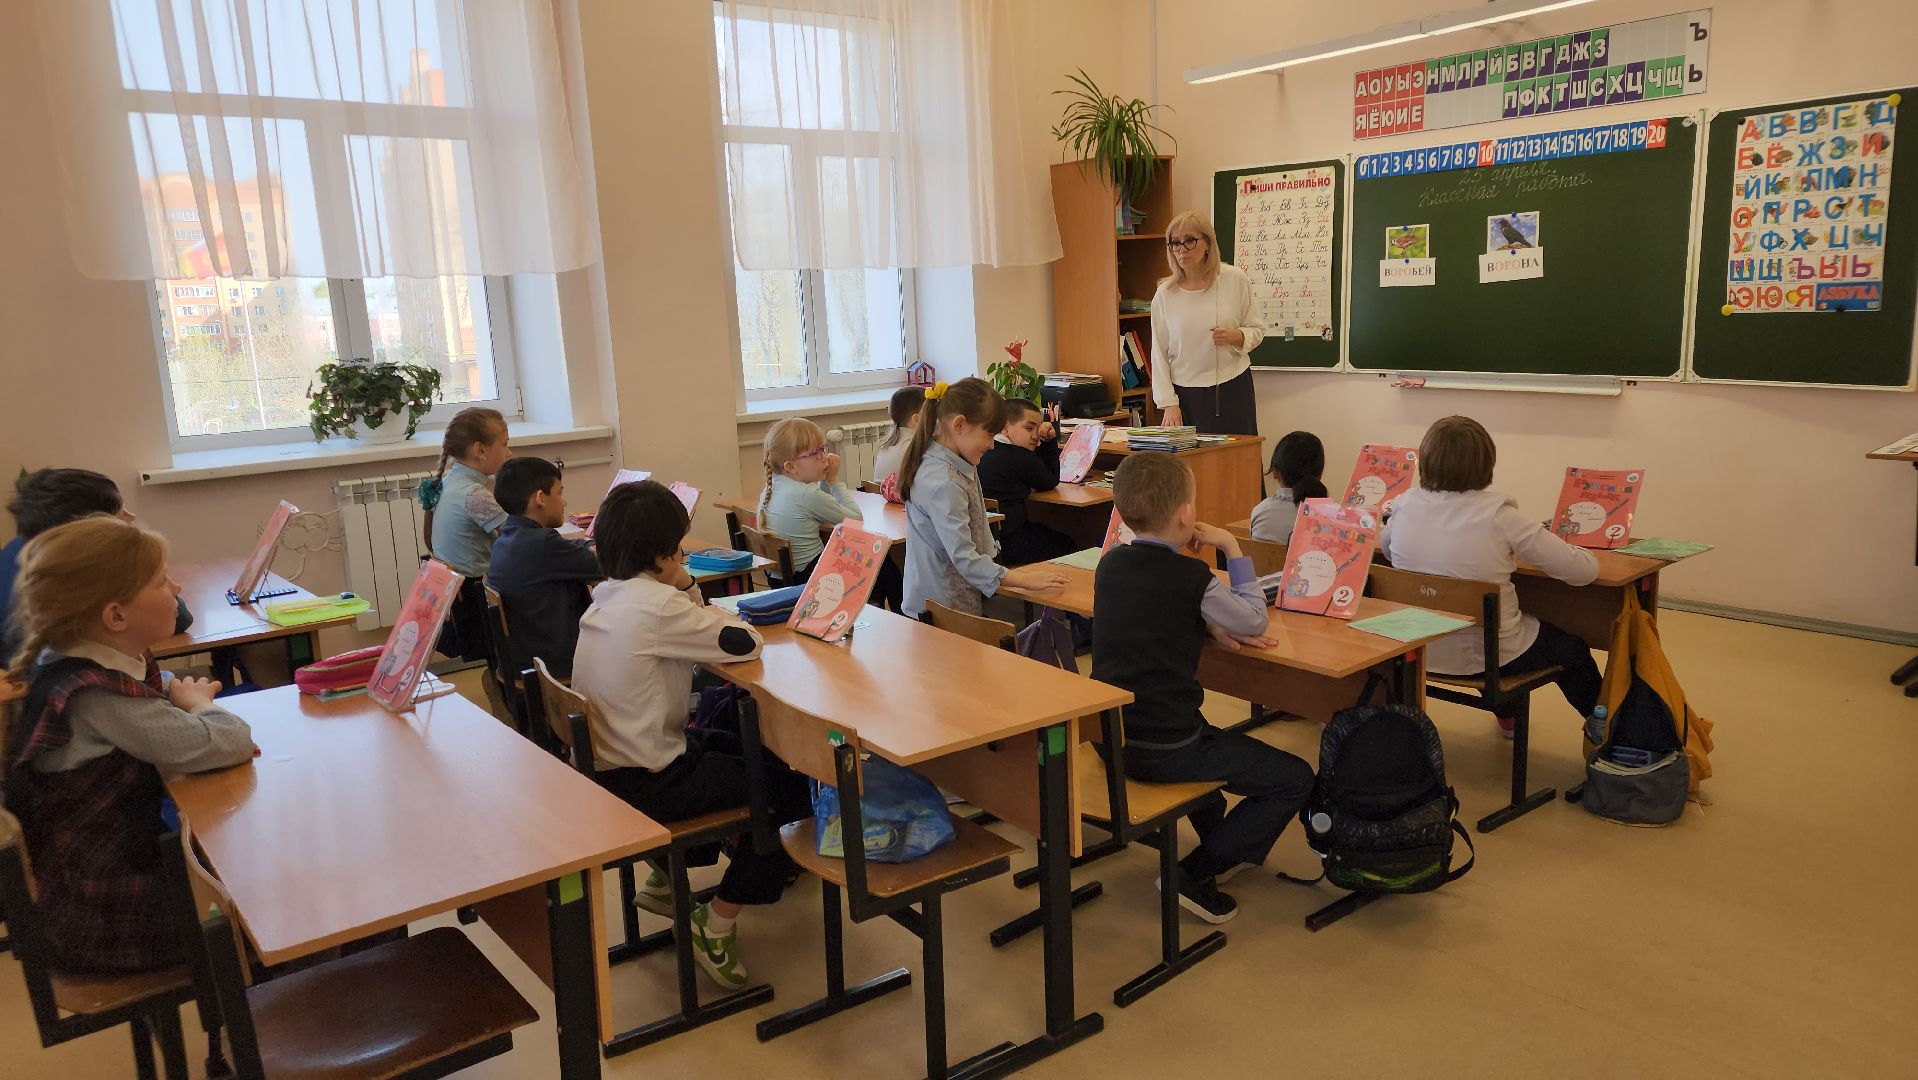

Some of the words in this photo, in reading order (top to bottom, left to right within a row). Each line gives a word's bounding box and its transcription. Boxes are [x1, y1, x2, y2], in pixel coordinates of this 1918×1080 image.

[1741, 120, 1760, 142] А
[1769, 114, 1787, 138] Б
[1800, 111, 1818, 134] В
[1833, 105, 1853, 130] Г
[1360, 159, 1368, 175] 0
[1372, 159, 1377, 174] 1
[1382, 157, 1389, 174] 2
[1393, 156, 1400, 172] 3
[1404, 154, 1413, 171] 4
[1416, 153, 1424, 170] 5
[1429, 152, 1437, 168] 6
[1442, 150, 1450, 166] 7
[1455, 148, 1463, 165] 8
[1468, 147, 1476, 164] 9
[1480, 144, 1493, 162] 10
[1496, 142, 1508, 161] 11
[1512, 141, 1525, 159] 12
[1528, 138, 1541, 157] 13
[1544, 137, 1558, 155] 14
[1561, 135, 1575, 153] 15
[1578, 132, 1592, 151] 16
[1595, 130, 1610, 149] 17
[1613, 128, 1628, 147] 18
[1631, 126, 1646, 145] 19
[1648, 124, 1665, 144] 20
[1738, 147, 1755, 170] Е
[1766, 142, 1784, 169] Ё
[1797, 141, 1825, 166] Ж
[1829, 136, 1847, 160] З
[1275, 177, 1331, 191] ПРАВИЛЬНО
[1744, 175, 1761, 199] Й
[1765, 173, 1780, 195] К
[1859, 163, 1878, 187] Н
[1763, 201, 1781, 224] П
[1793, 199, 1810, 222] Р
[1824, 196, 1844, 219] С
[1859, 194, 1877, 217] Т
[1733, 232, 1750, 254] У
[1760, 230, 1781, 252] Ф
[1789, 228, 1810, 251] Х
[1829, 225, 1849, 250] Ц
[1863, 223, 1883, 246] Ч
[1385, 265, 1431, 276] ВОРОБЕЙ
[1487, 257, 1539, 272] ВОРОНА
[1729, 260, 1755, 281] Ш
[1758, 259, 1783, 281] Щ
[1792, 258, 1816, 279] Ъ
[1819, 256, 1848, 278] Ы
[1851, 255, 1872, 278] Ь
[1735, 287, 1754, 308] Э
[1756, 286, 1783, 308] Ю
[1795, 285, 1815, 307] Я
[1609, 526, 1621, 537] 2
[1337, 589, 1349, 604] 2
